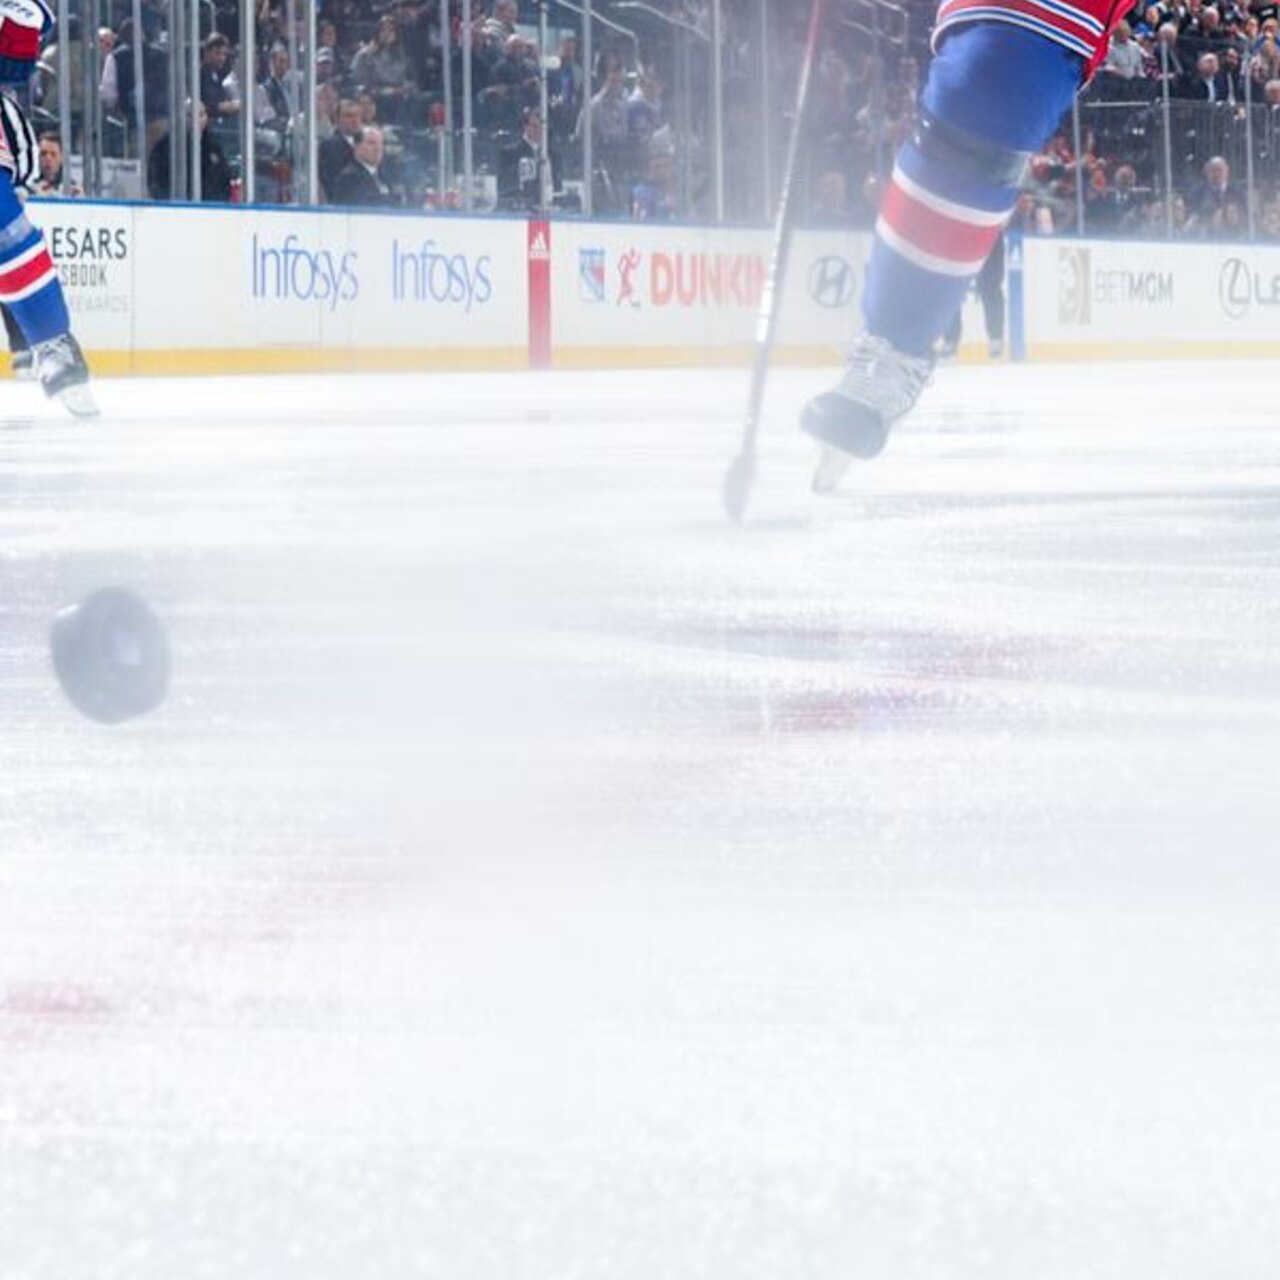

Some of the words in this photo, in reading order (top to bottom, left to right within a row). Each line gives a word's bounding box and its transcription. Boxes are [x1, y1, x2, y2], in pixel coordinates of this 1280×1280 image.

[52, 227, 127, 259] ESARS
[252, 233, 359, 312] Infosys
[392, 238, 492, 313] Infosys
